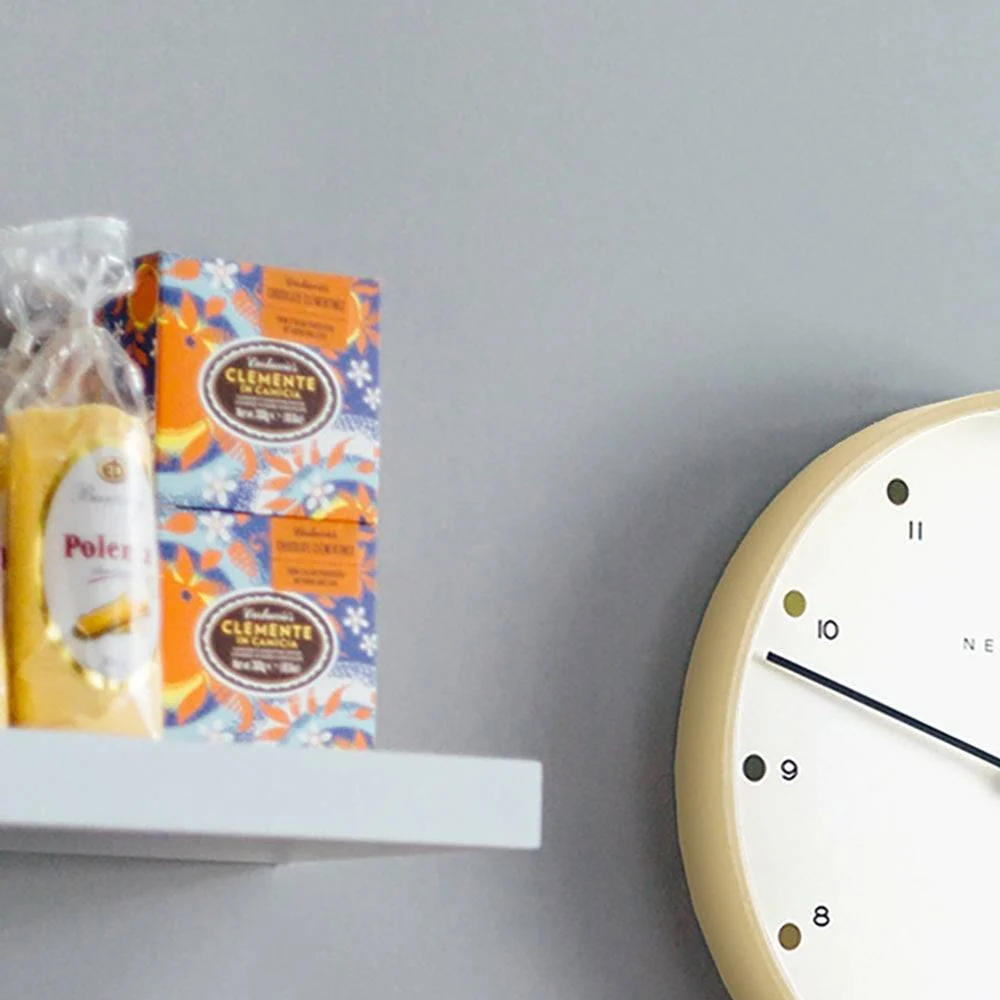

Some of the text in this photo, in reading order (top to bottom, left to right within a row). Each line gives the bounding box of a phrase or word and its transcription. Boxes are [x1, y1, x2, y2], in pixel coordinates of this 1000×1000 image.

[224, 367, 316, 392] CLEMENTE
[908, 521, 923, 541] 11
[221, 619, 313, 641] CLEMENTE
[817, 619, 840, 640] 10
[780, 758, 799, 781] 9
[812, 905, 831, 927] 8
